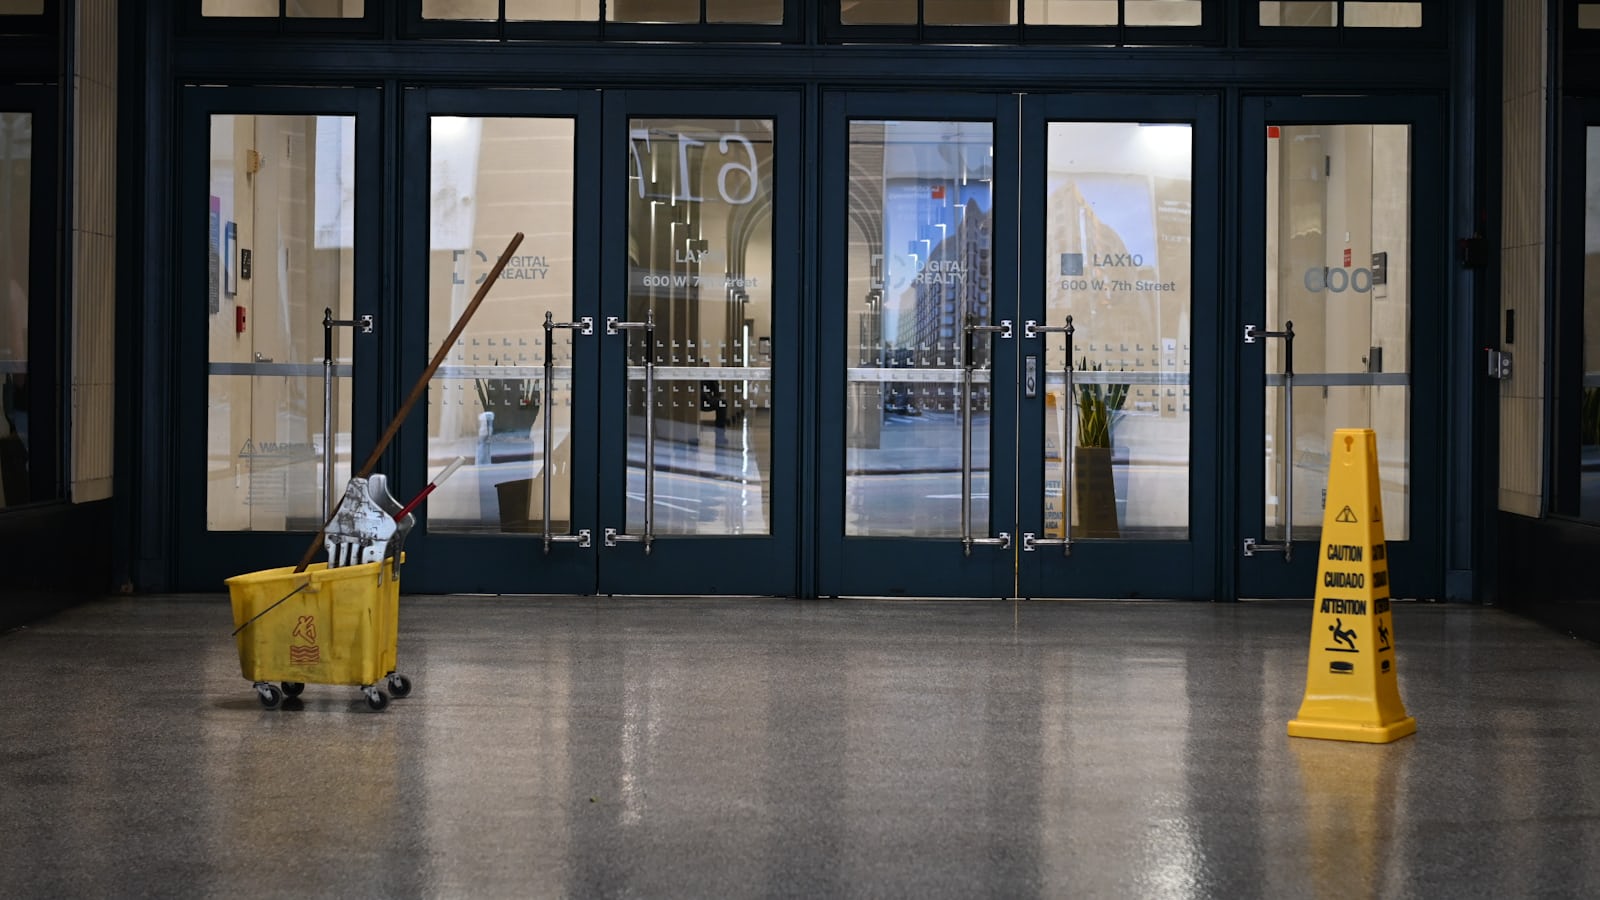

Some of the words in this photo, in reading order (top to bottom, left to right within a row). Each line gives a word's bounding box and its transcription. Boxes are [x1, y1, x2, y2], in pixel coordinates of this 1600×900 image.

[497, 256, 549, 267] GITAL
[675, 249, 723, 263] LAX
[1093, 254, 1143, 267] LAX10
[916, 260, 968, 272] DIGITAL
[643, 275, 670, 287] 600
[718, 275, 758, 287] treet
[915, 272, 968, 284] REALTY
[1304, 267, 1373, 293] 600
[1061, 280, 1088, 291] 600
[1091, 280, 1108, 291] W.
[1111, 280, 1132, 291] 7th
[1135, 280, 1176, 292] Street
[1327, 544, 1363, 562] CAUTION
[1324, 571, 1365, 589] CUIDADO
[1320, 598, 1366, 616] ATTENTION
